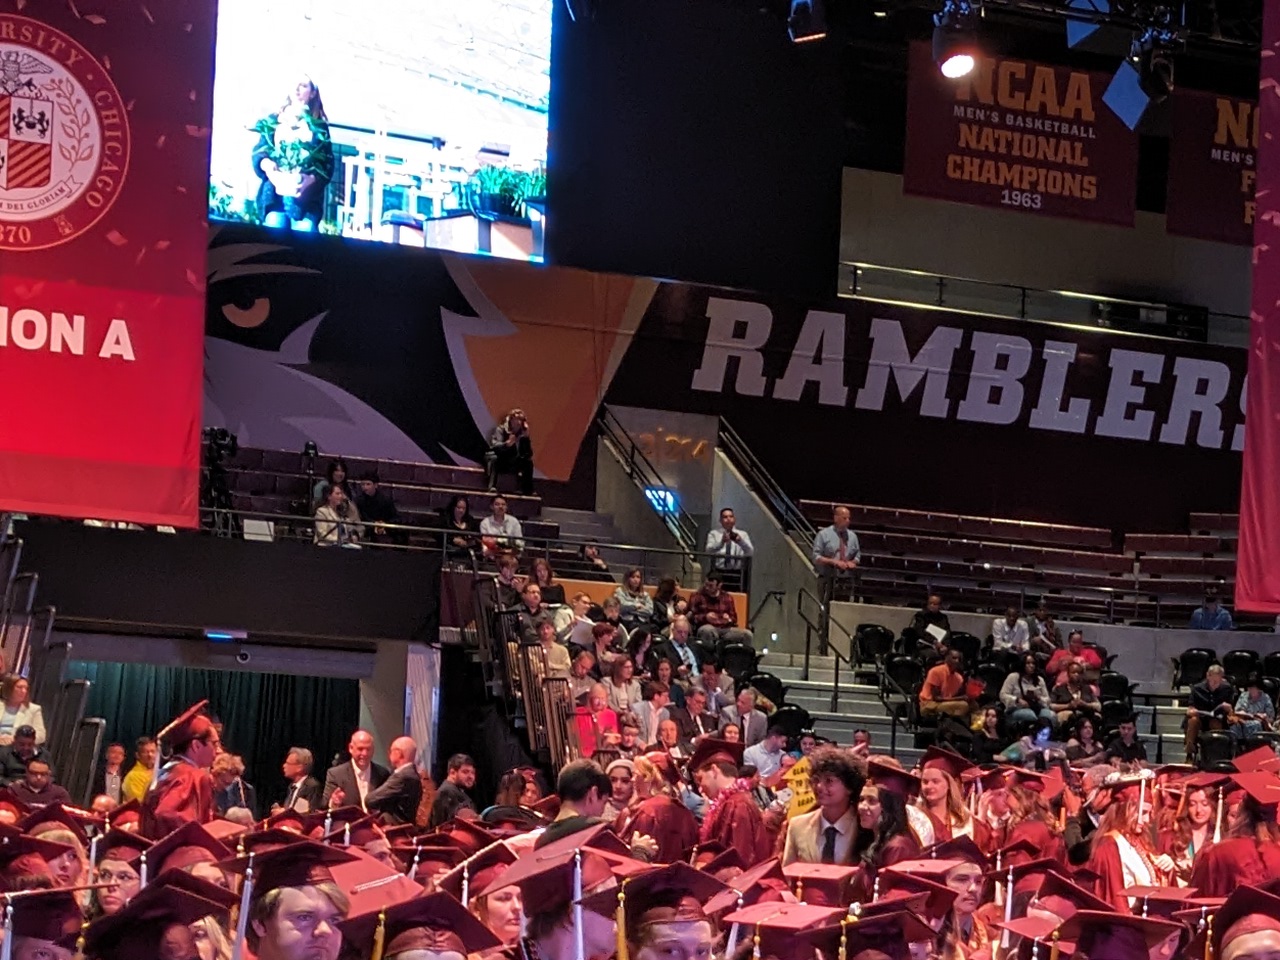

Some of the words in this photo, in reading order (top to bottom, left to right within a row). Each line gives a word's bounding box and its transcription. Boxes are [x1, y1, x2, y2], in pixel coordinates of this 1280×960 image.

[955, 57, 1095, 122] NCAA
[953, 104, 1000, 124] MEN'S
[1006, 113, 1096, 139] BASKETBALL
[86, 90, 122, 208] CHICAGO
[957, 122, 1089, 167] NATIONAL
[1211, 148, 1254, 166] MEN'S
[946, 153, 1097, 200] CHAMPIONS
[1001, 189, 1042, 209] 1963
[98, 318, 136, 361] A
[691, 297, 1248, 452] RAMBLER
